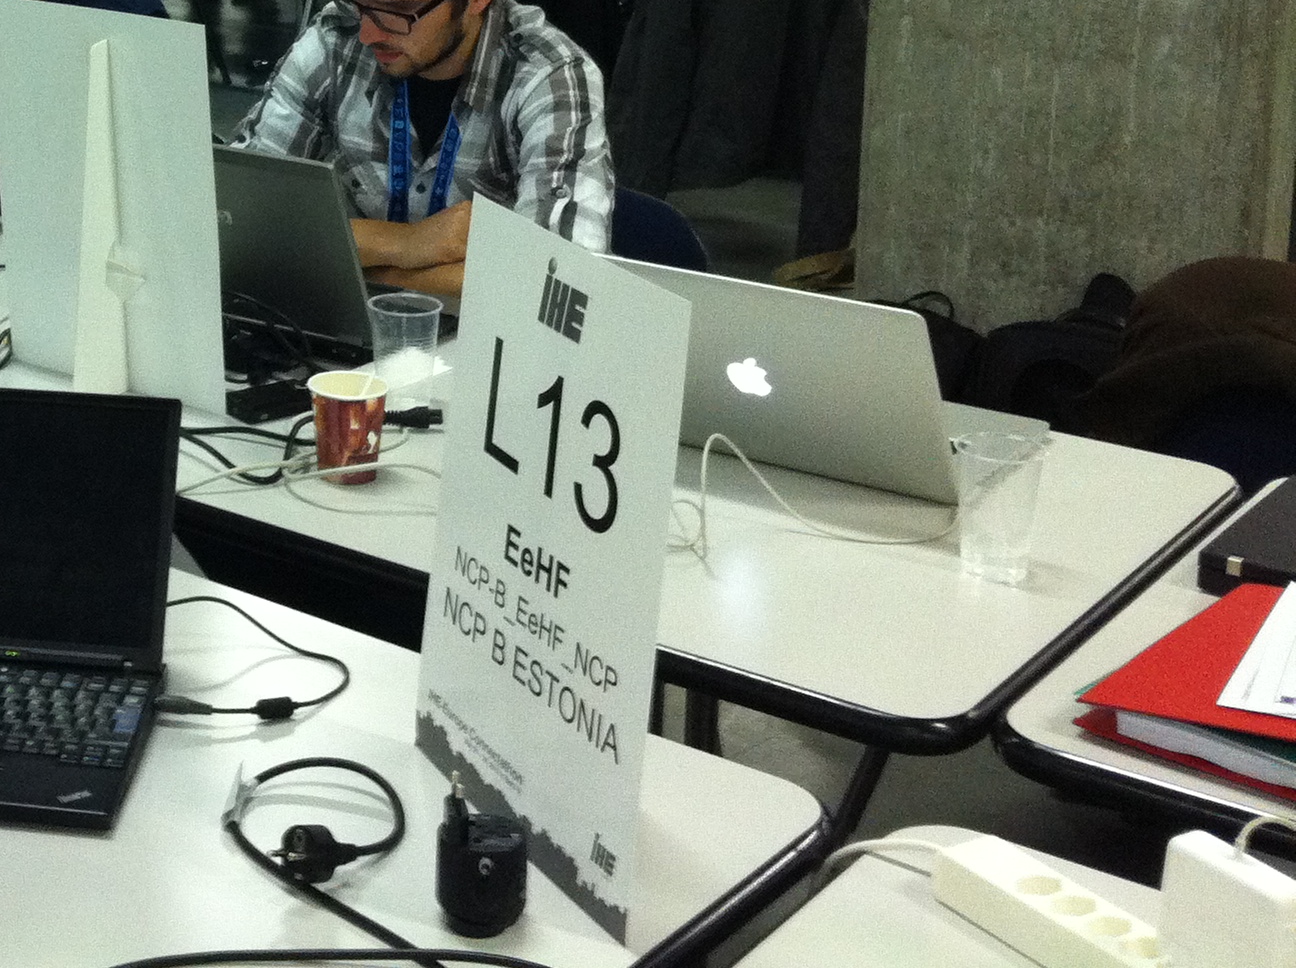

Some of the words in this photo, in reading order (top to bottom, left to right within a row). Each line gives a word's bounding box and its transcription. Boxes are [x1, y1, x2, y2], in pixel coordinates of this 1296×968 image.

[483, 335, 621, 534] L13
[454, 545, 619, 694] NCP-B_EeHF_NCP
[503, 522, 571, 599] EeHF
[443, 586, 487, 644] NCP
[491, 628, 506, 666] B
[512, 644, 619, 765] ESTONIA
